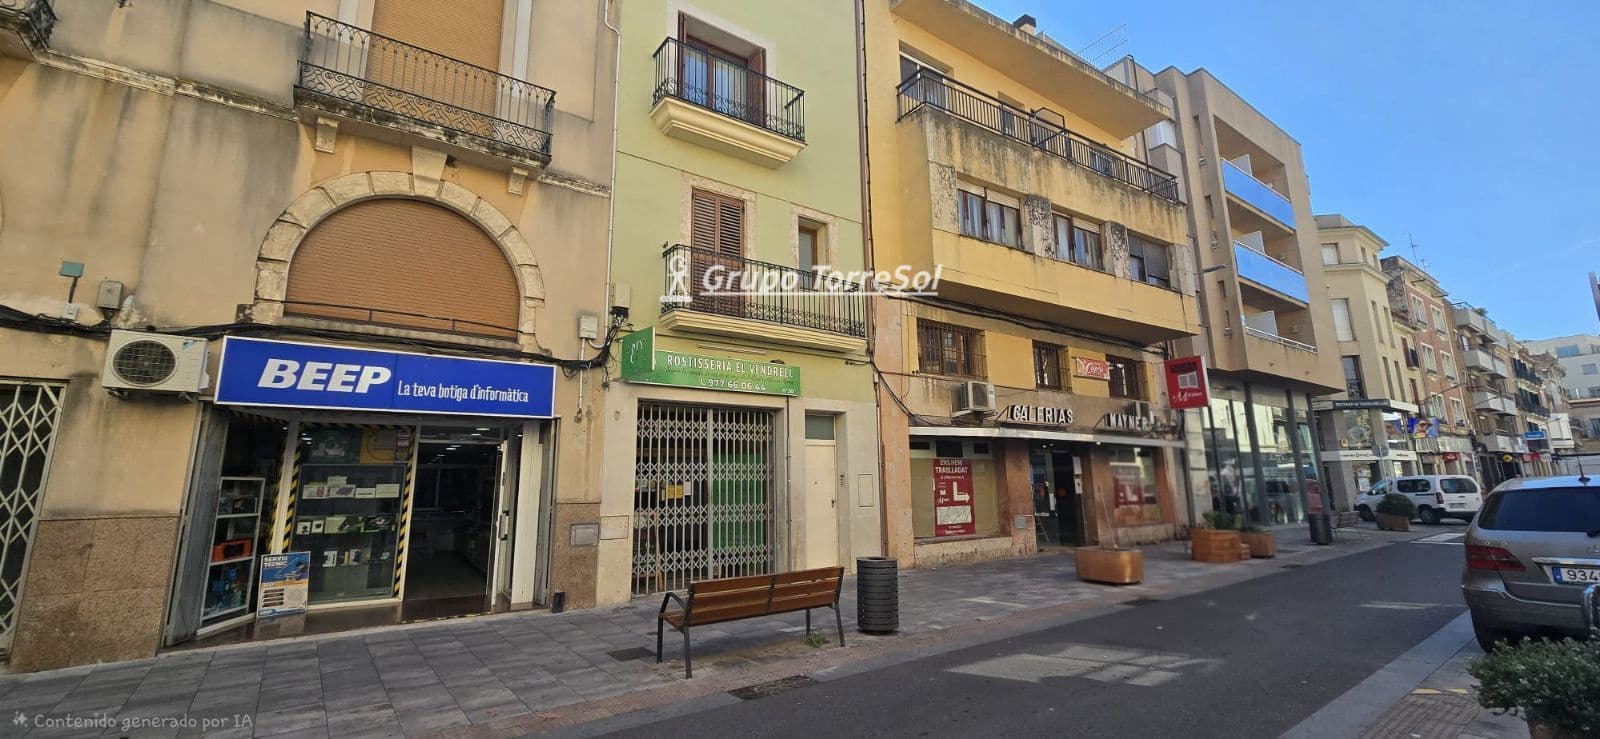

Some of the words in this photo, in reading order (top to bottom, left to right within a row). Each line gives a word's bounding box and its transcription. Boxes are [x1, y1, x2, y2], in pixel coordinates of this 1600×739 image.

[257, 358, 392, 394] BEEP
[667, 354, 732, 372] ROSTISSERIA
[736, 363, 745, 373] EL
[749, 364, 793, 378] VENDRELL
[398, 380, 410, 396] La
[413, 382, 436, 397] teva
[438, 383, 468, 401] botiga
[470, 384, 529, 402] d'informàtica
[709, 379, 724, 387] 977
[728, 381, 738, 389] 66
[1013, 404, 1074, 424] GALERIAS
[1567, 569, 1600, 581] 934
